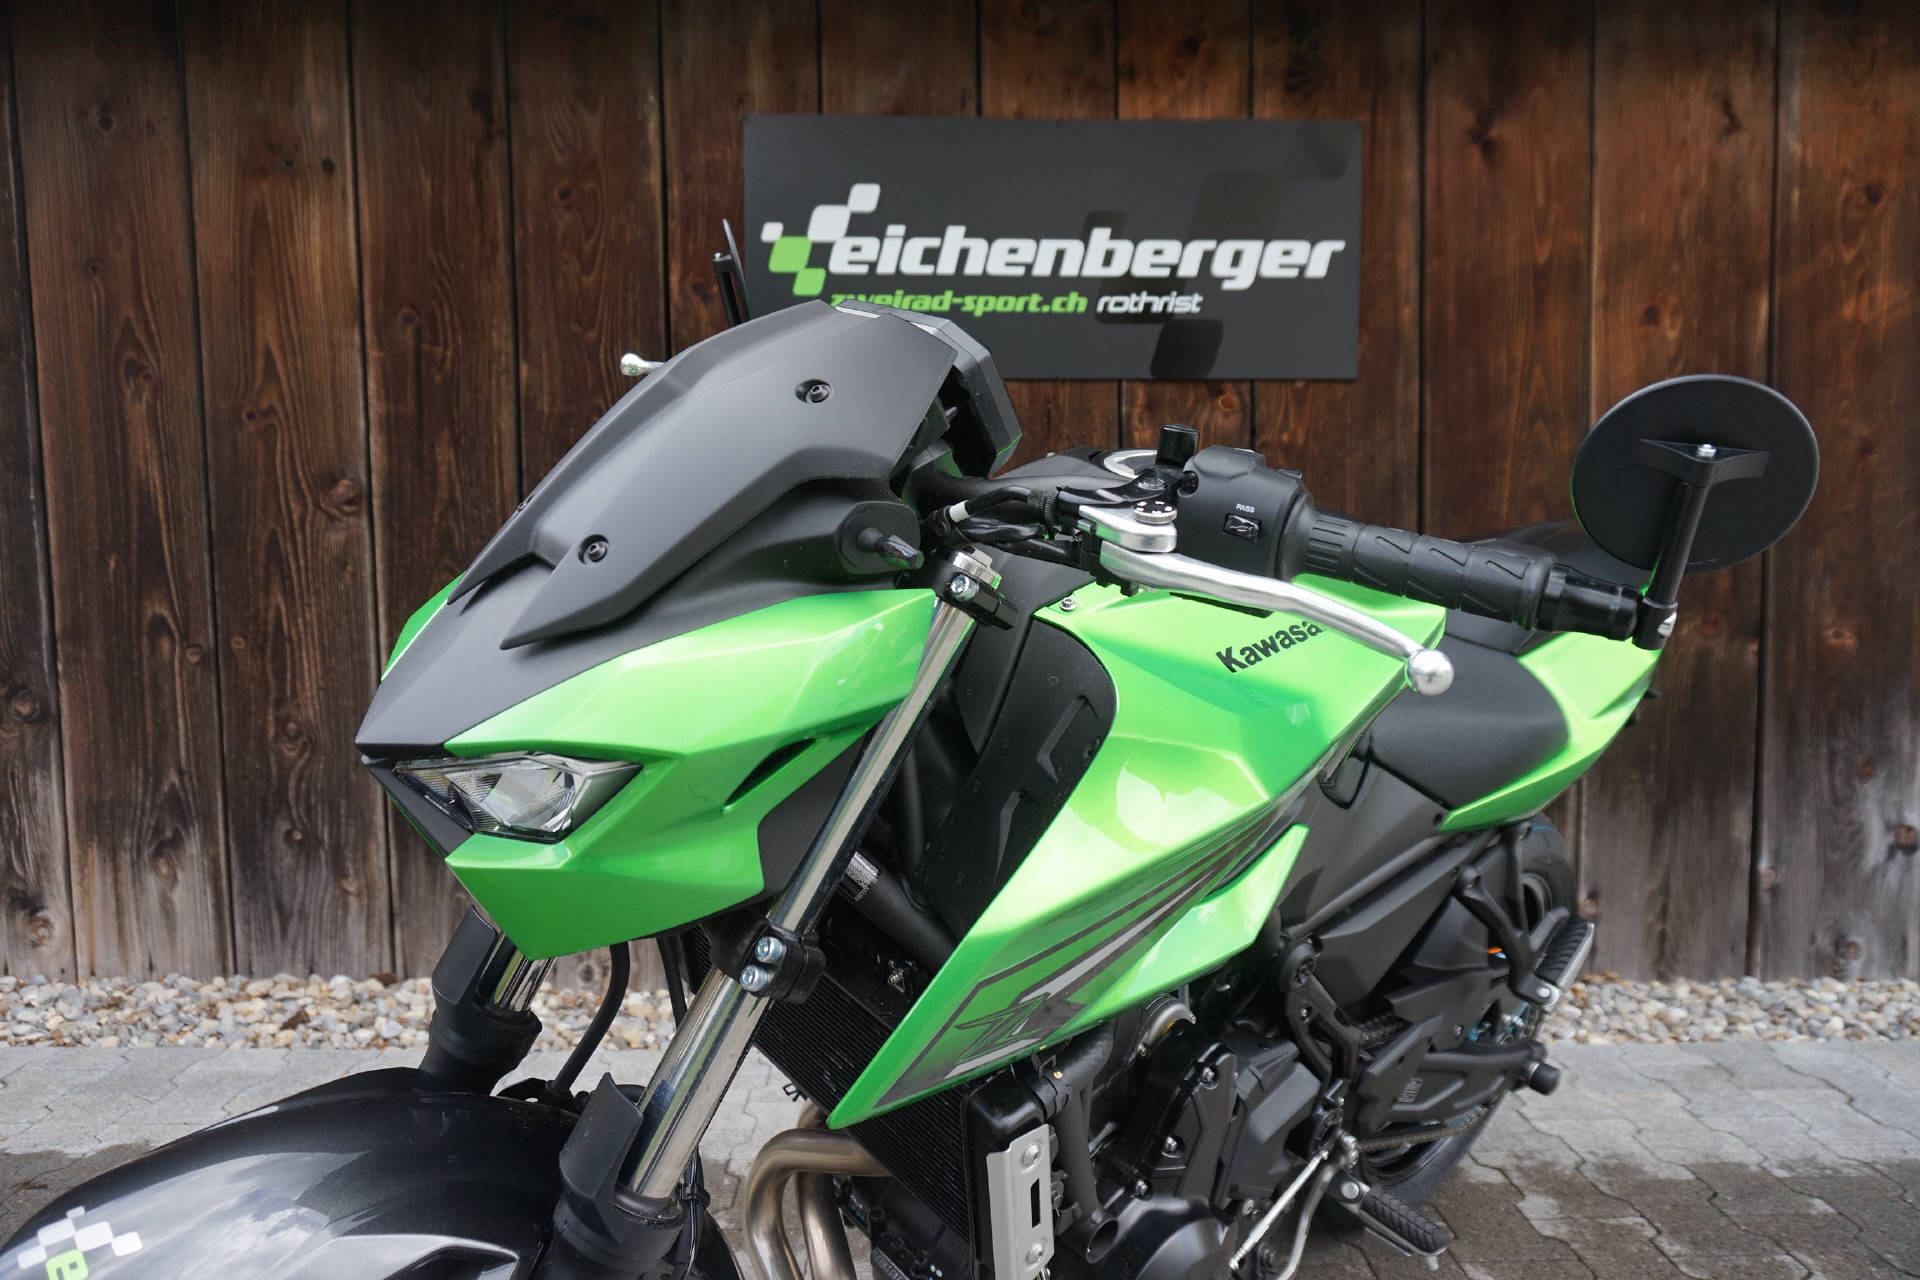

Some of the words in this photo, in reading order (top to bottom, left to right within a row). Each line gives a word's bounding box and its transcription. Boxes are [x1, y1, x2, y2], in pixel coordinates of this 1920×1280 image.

[828, 224, 1346, 290] eichenberger
[1096, 290, 1204, 313] rothrist
[1236, 503, 1255, 513] PASS
[1215, 620, 1324, 673] Kawasa
